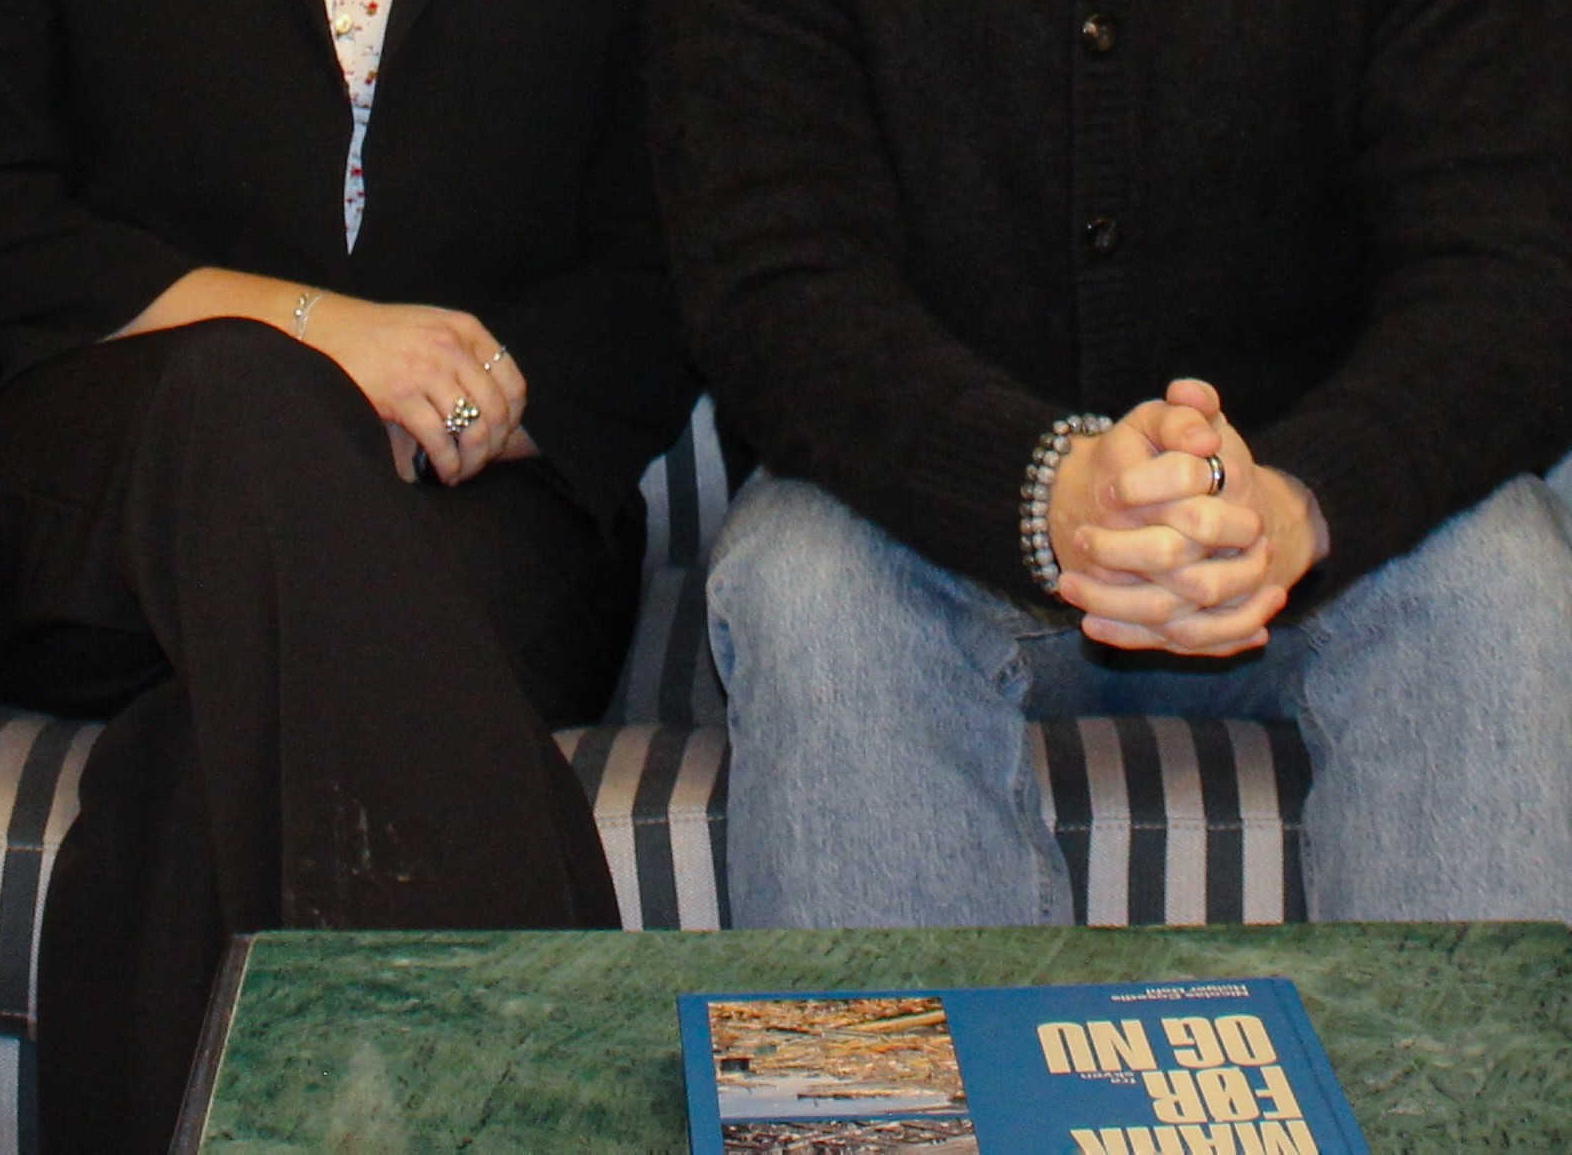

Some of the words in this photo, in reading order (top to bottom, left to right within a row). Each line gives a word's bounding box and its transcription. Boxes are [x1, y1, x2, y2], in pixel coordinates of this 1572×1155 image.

[1036, 1019, 1158, 1074] NU
[1161, 1014, 1277, 1069] OG
[1141, 1065, 1303, 1124] FØR
